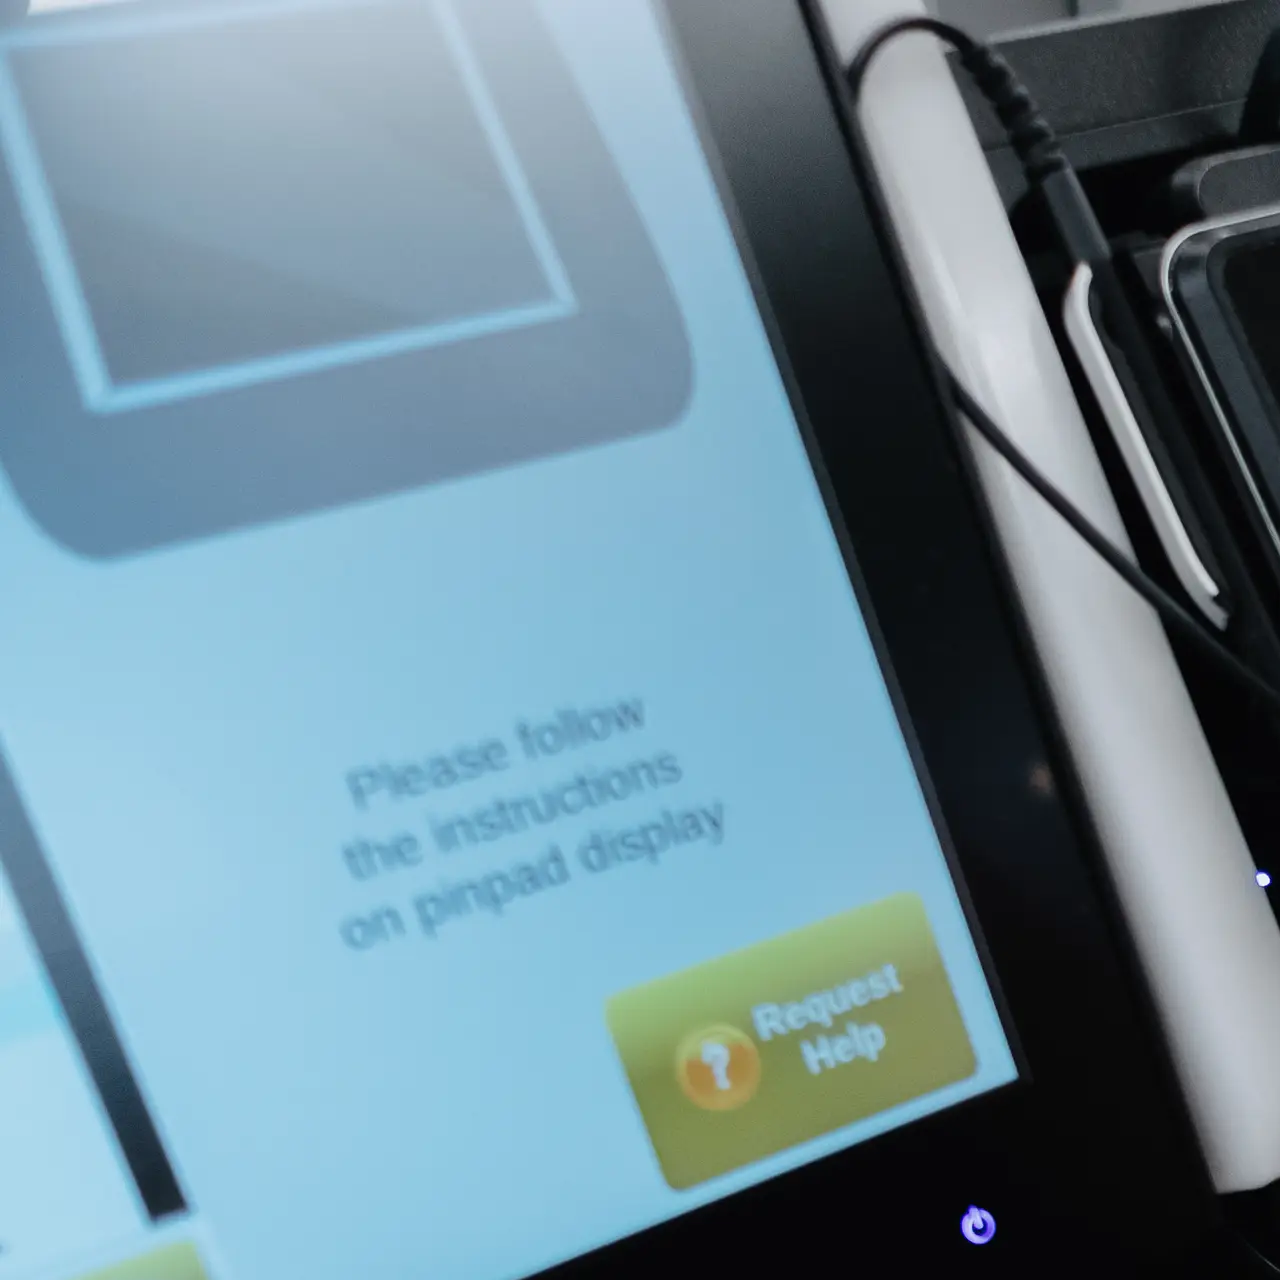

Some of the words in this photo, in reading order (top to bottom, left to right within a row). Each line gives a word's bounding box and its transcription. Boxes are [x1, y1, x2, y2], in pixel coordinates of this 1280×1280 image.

[345, 737, 510, 811] Please
[515, 697, 645, 760] follow
[342, 832, 423, 881] the
[430, 750, 684, 853] instructions
[339, 906, 406, 950] on
[413, 844, 571, 938] pinpad
[577, 801, 724, 874] display
[752, 963, 903, 1042] Request
[800, 1021, 886, 1075] Help
